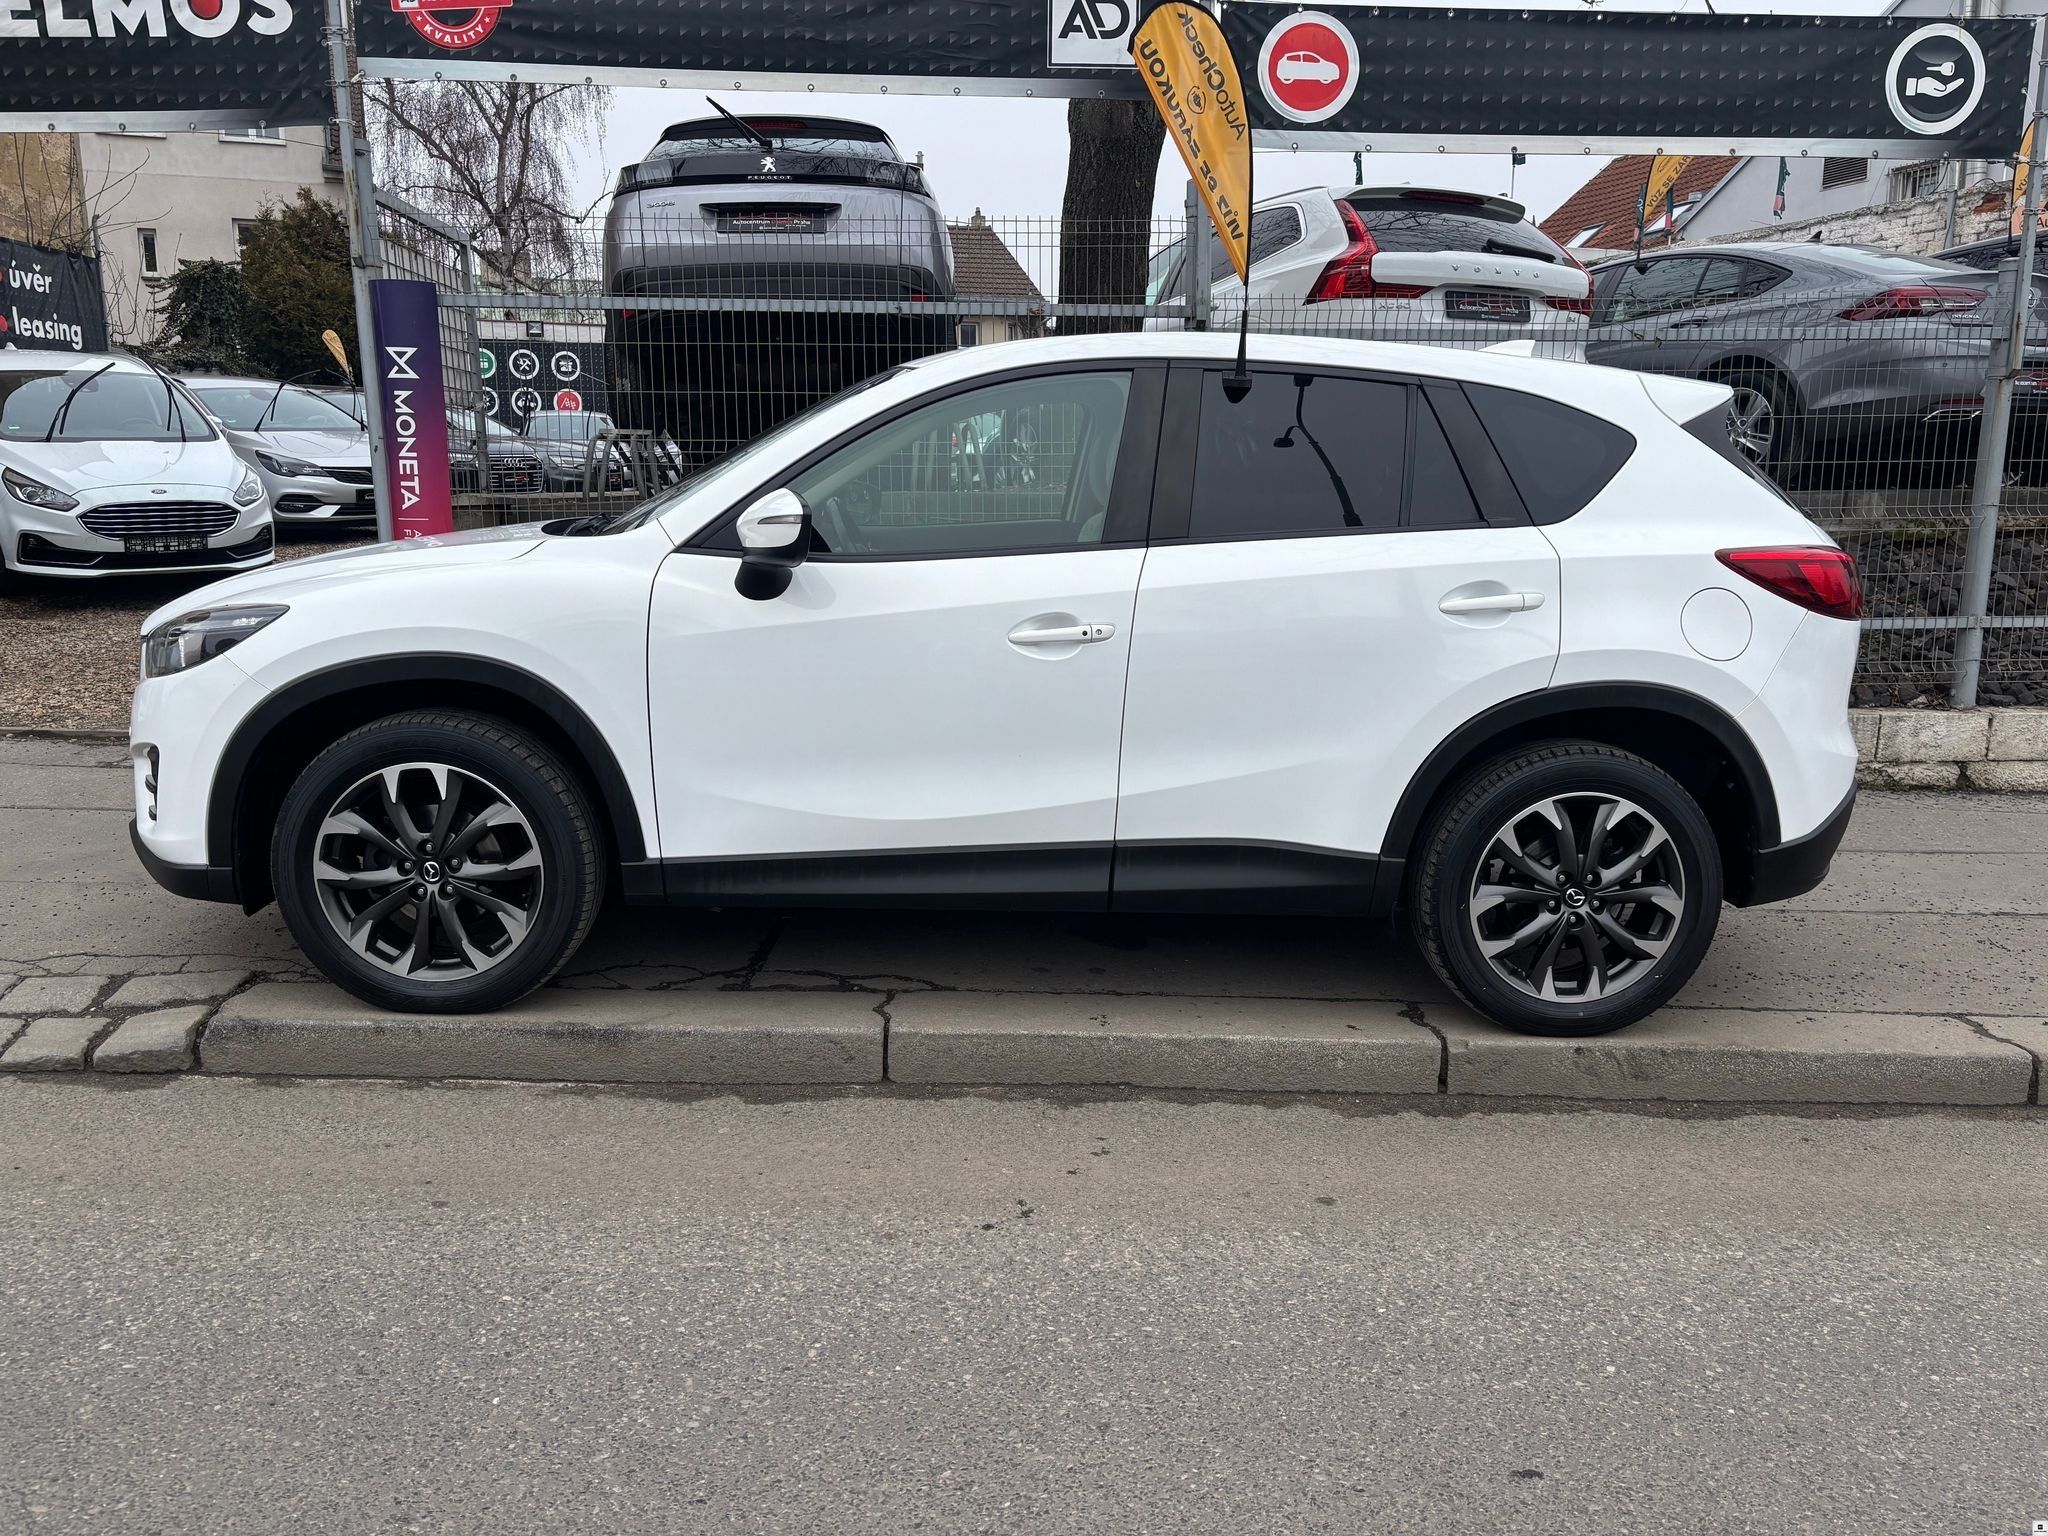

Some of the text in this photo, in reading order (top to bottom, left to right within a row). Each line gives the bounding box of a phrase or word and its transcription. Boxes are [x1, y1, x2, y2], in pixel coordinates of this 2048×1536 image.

[423, 23, 485, 43] KVALITY
[1662, 175, 1675, 189] SE
[9, 259, 53, 294] úvěr
[1451, 264, 1541, 279] VOLVO
[12, 305, 84, 350] leasing
[393, 390, 421, 510] MONETA
